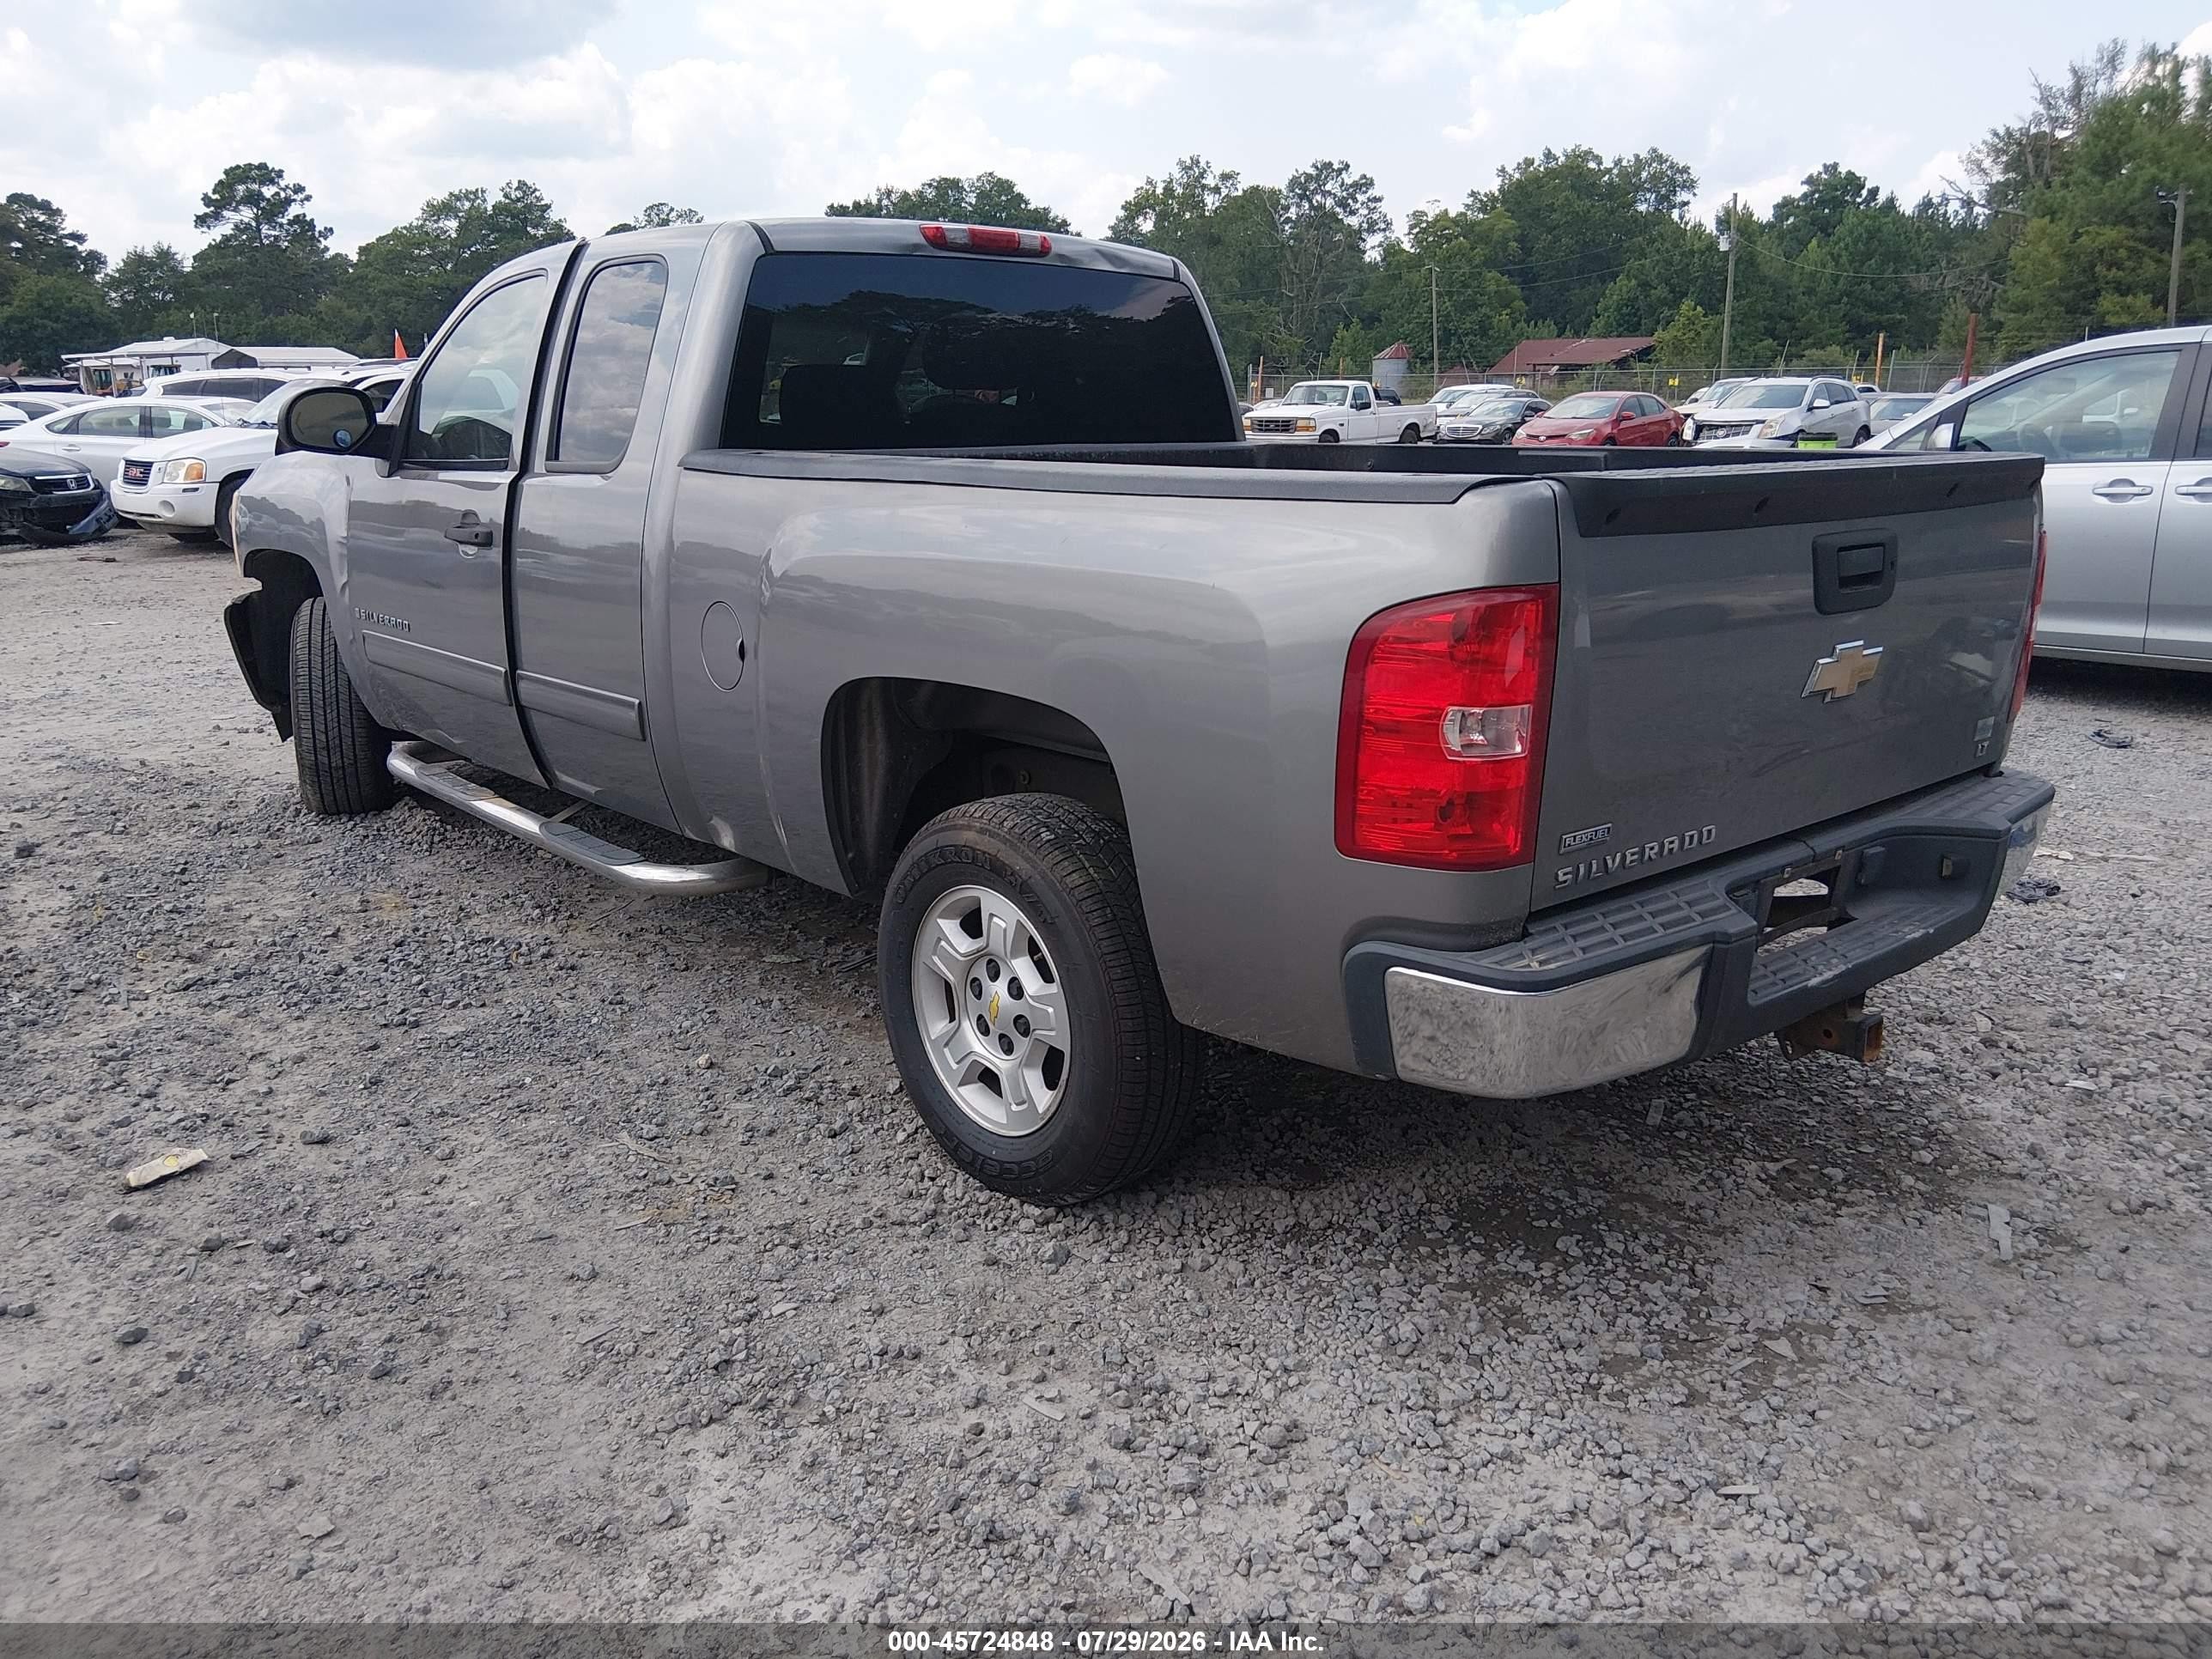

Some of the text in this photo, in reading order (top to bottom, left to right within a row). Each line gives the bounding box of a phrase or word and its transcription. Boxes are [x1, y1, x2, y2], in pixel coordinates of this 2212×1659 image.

[361, 609, 410, 632] SILVERADO
[1565, 828, 1611, 848] FLEXFUEL
[1554, 824, 1717, 889] SILVERADO
